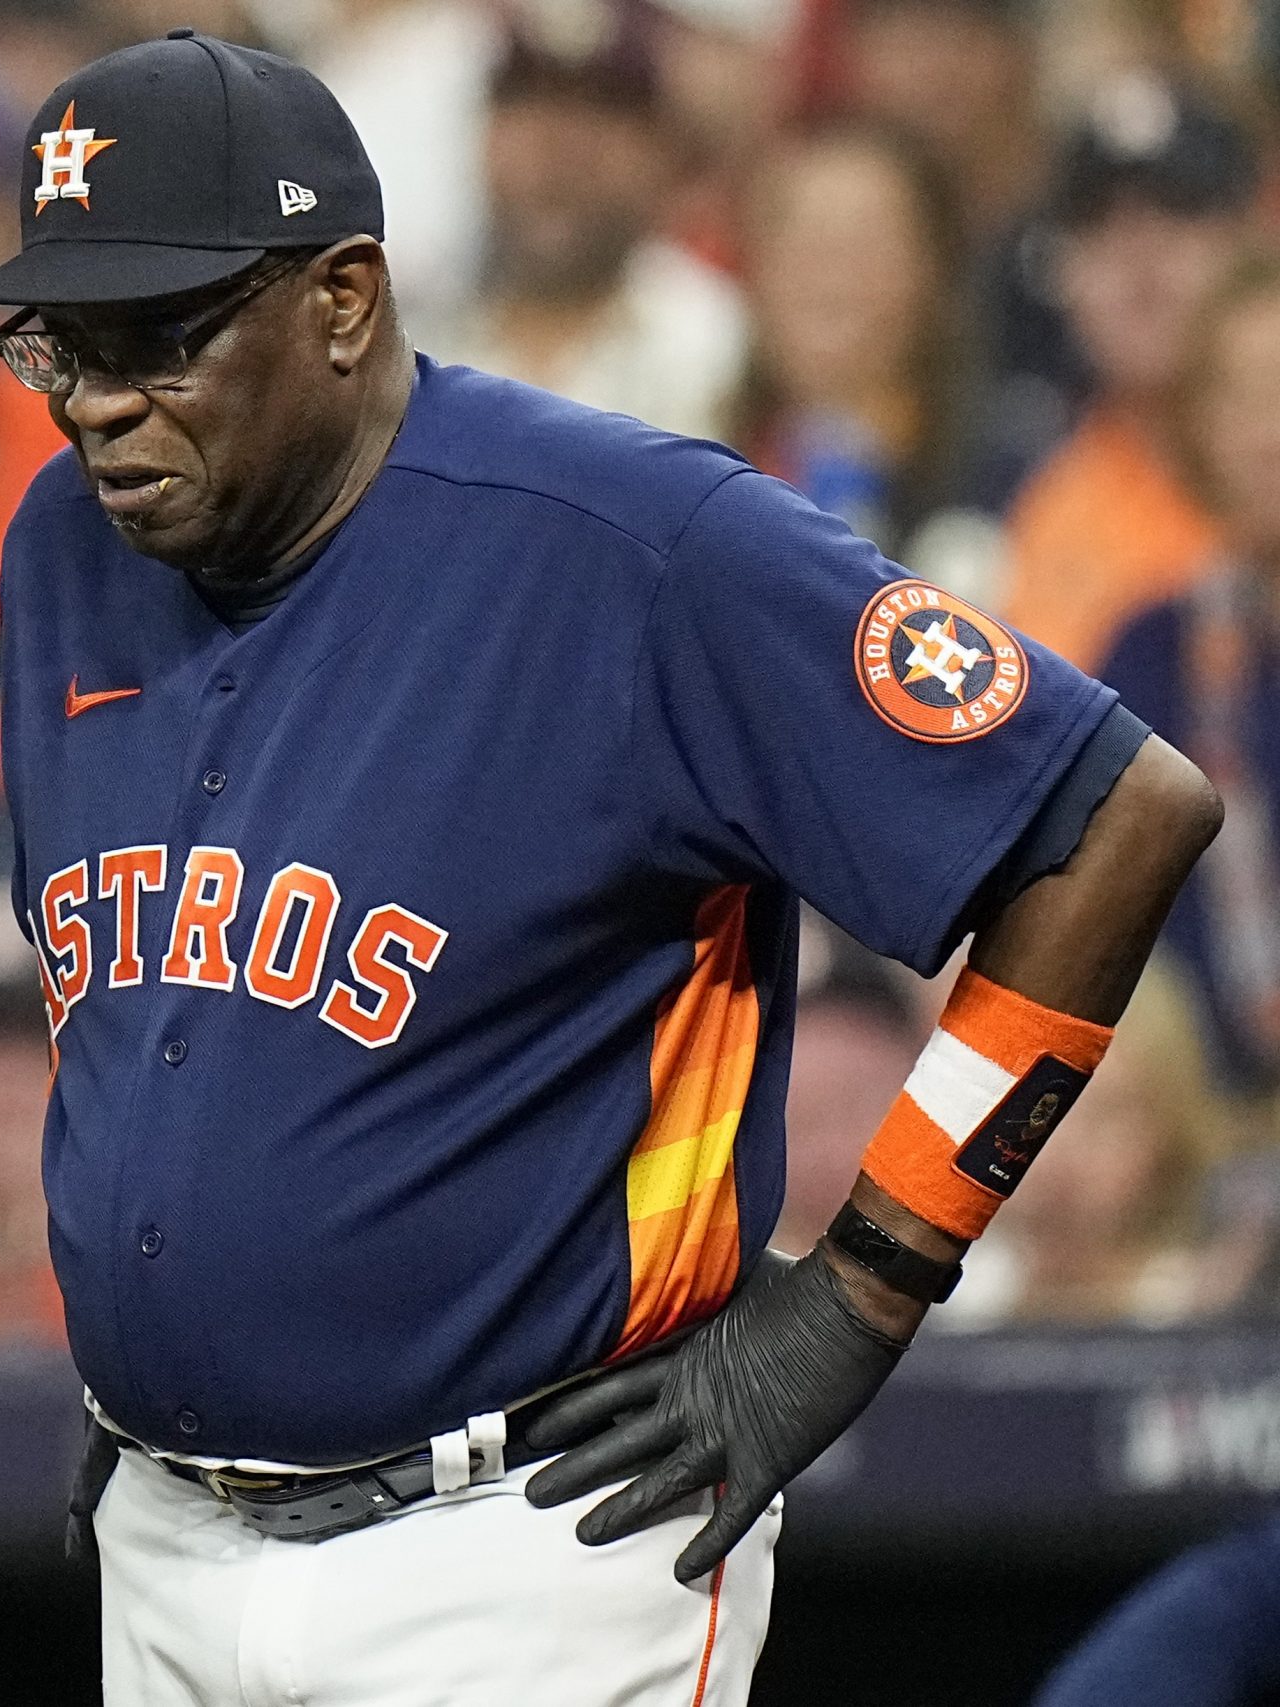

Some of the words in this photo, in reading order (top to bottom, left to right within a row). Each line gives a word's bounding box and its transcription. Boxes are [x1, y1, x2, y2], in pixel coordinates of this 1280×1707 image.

[35, 128, 95, 201] H
[866, 588, 941, 684] HOUSTON
[951, 647, 1019, 731] ASTROS
